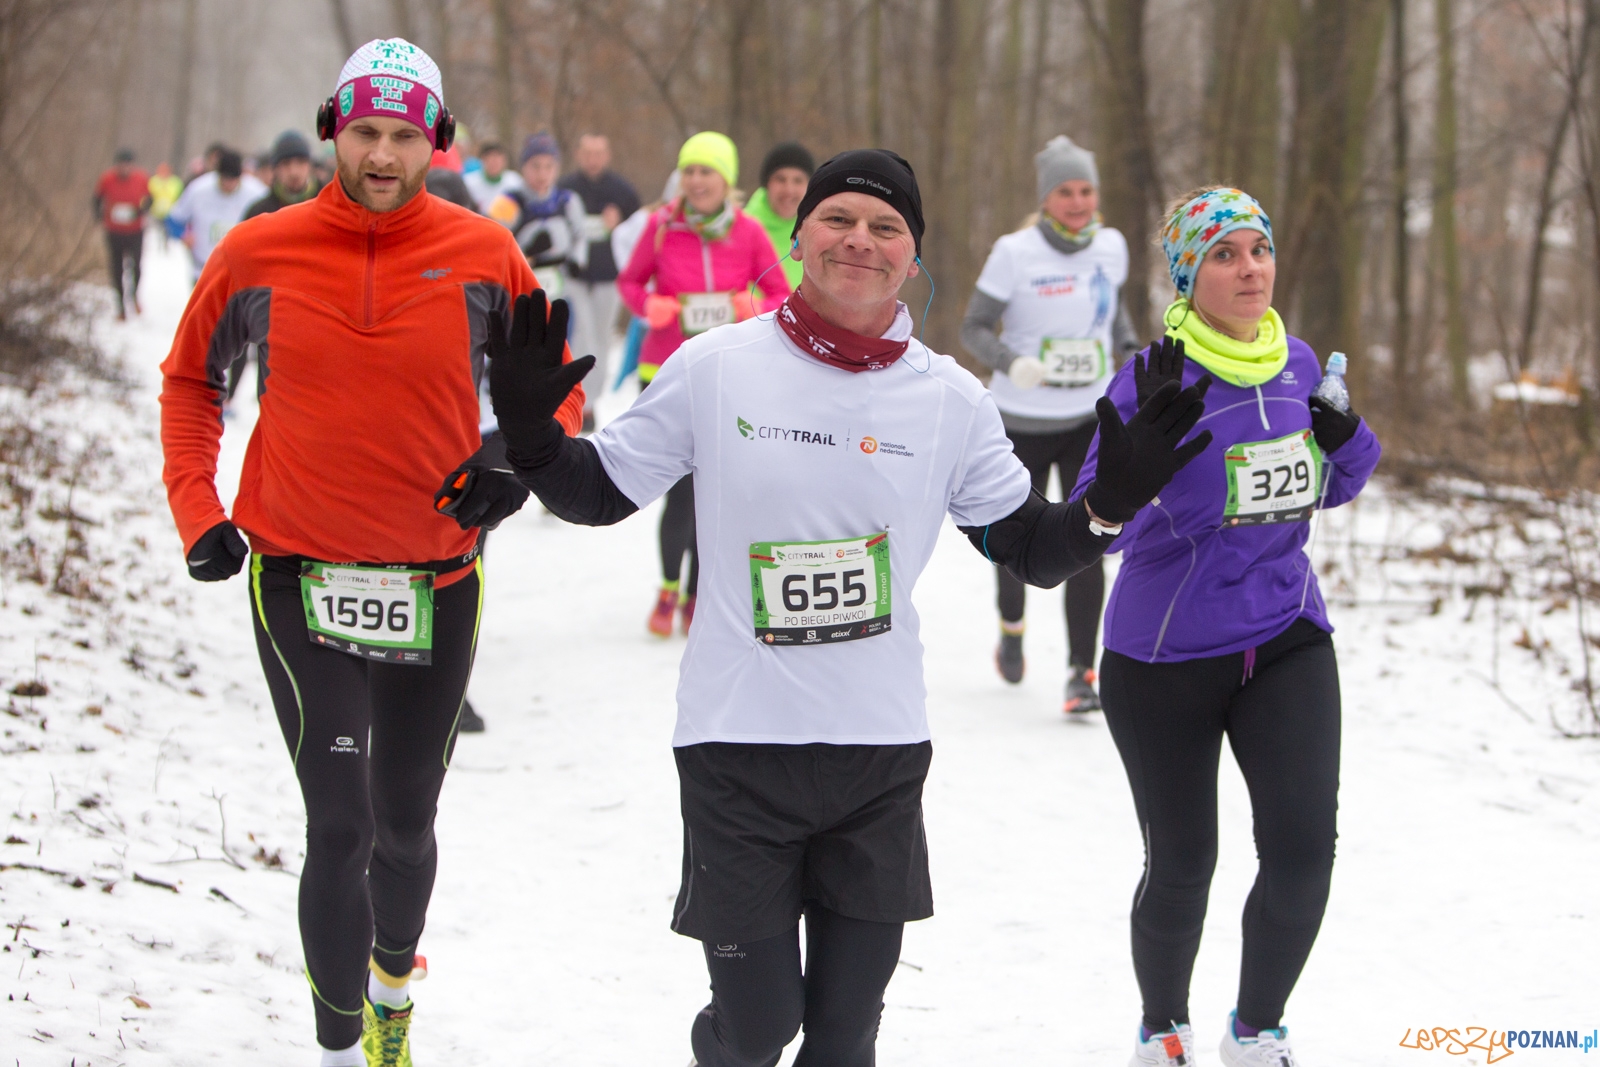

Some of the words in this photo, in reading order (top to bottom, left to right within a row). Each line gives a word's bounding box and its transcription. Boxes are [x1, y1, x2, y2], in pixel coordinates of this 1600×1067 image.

[382, 48, 409, 62] Tri
[370, 59, 419, 77] Team
[380, 87, 402, 100] Tri
[372, 98, 407, 113] Team
[866, 179, 893, 195] Kalenji
[1054, 354, 1093, 373] 295
[879, 447, 915, 458] nederlanden
[880, 441, 906, 450] nationale
[1251, 460, 1310, 501] 329
[1270, 499, 1298, 510] FEFCIA
[782, 568, 867, 612] 655
[880, 572, 888, 605] Poznań
[321, 595, 409, 632] 1596
[784, 616, 798, 626] PO
[801, 614, 831, 626] BIEGU
[832, 610, 867, 623] PIWKO!
[419, 607, 428, 639] Poznań
[713, 950, 746, 958] Kalenji
